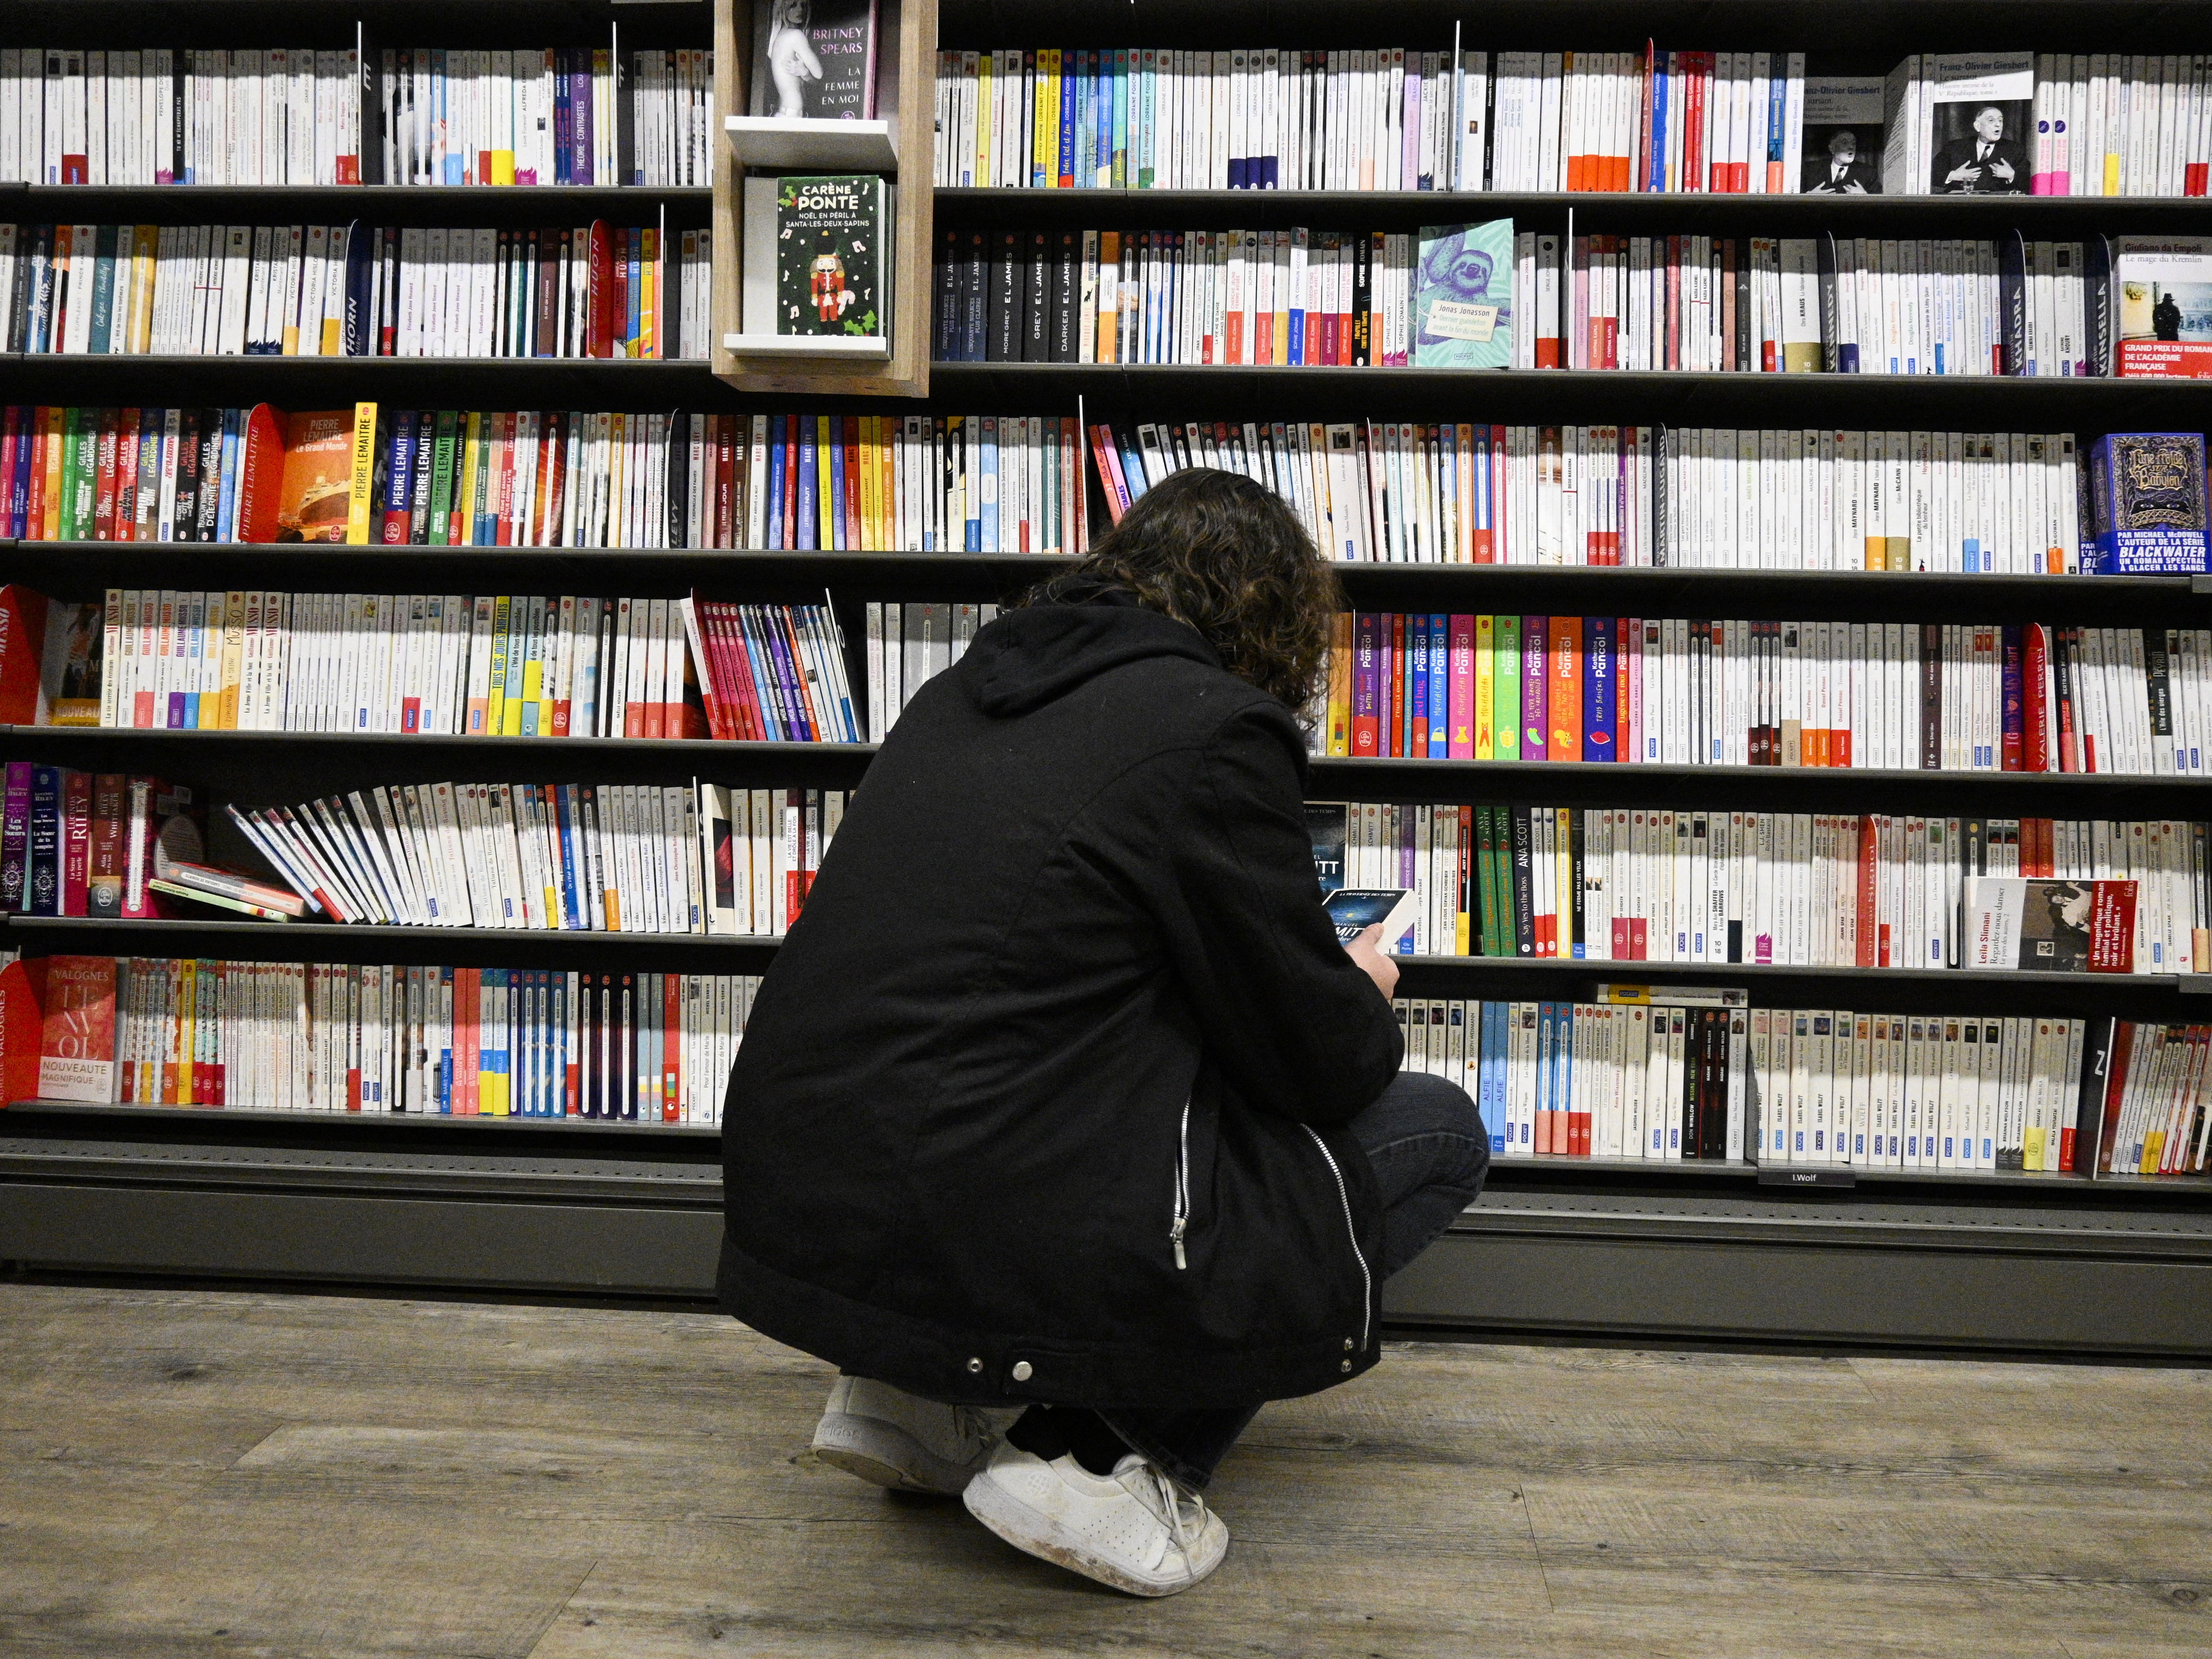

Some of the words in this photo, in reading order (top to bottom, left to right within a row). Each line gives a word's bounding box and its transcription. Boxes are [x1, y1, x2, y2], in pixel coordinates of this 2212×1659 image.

[813, 27, 864, 40] BRITNEY
[821, 42, 863, 55] SPEARS
[849, 67, 861, 76] LA
[825, 81, 860, 91] FEMME
[822, 96, 834, 105] EN
[838, 95, 859, 104] MOI
[577, 101, 585, 140] CONTRASTES
[802, 182, 851, 195] CARÈNE
[798, 195, 859, 211] PONTE
[2125, 243, 2159, 252] Giuliano
[2174, 243, 2202, 253] Empoli
[590, 237, 599, 296] HUON
[2137, 256, 2157, 264] mage
[2172, 254, 2202, 263] Kremlin
[1438, 304, 1458, 314] Jonas
[1459, 307, 1490, 317] Jonasson
[347, 297, 357, 353] HORN
[1440, 314, 1458, 324] Dernier
[1459, 317, 1487, 327] gueuleton
[1826, 283, 1836, 371] KENNEDY
[2012, 286, 2023, 366] KHADRA
[2097, 282, 2108, 373] KINSELLA
[1433, 324, 1448, 333] avant
[1471, 328, 1489, 337] monde
[2137, 353, 2181, 361] L'ACADÉMIE
[2125, 363, 2166, 371] FRANÇAISE
[305, 443, 324, 452] Grand
[326, 442, 347, 451] Monde
[357, 418, 371, 463] LEMAITRE
[79, 441, 88, 467] GILLES
[86, 430, 97, 477] LEGARDINIER
[247, 425, 259, 489] LEMAITRE
[355, 465, 367, 499] PIERRE
[1658, 434, 1667, 564] MARTIN-LUGAND
[243, 493, 255, 536] PIERRE
[2118, 538, 2157, 546] L'AUTEUR
[2183, 538, 2204, 546] SÉRIE
[2119, 546, 2206, 557] BLACKWATER
[105, 605, 121, 634] MUSSO
[495, 603, 509, 634] PARFAITS
[494, 635, 507, 655] JOURS
[1434, 634, 1445, 674] Pancol
[1595, 637, 1606, 678] Pancol
[493, 656, 505, 671] NOS
[493, 673, 504, 690] TOUS
[1595, 707, 1604, 722] TROIS
[2037, 705, 2046, 765] VALERIE
[72, 796, 88, 840] RILEY
[1516, 817, 1528, 849] SCOTT
[1517, 851, 1529, 868] ANA
[1520, 876, 1528, 890] Boss
[2124, 880, 2135, 897] folio
[1520, 892, 1529, 902] the
[1993, 887, 2005, 910] danser
[2097, 882, 2106, 906] roman
[1521, 911, 1530, 923] Yes
[2104, 894, 2115, 927] politique,
[1521, 924, 1530, 936] Say
[1980, 911, 1991, 942] Slimani
[2094, 909, 2106, 948] magnifique
[2103, 930, 2112, 938] et
[2111, 912, 2122, 941] brûlant.
[1990, 913, 2002, 964] Regardez-nous
[1978, 944, 1988, 964] Leïla
[2002, 945, 2010, 956] pays
[2093, 950, 2101, 960] Un
[2101, 940, 2112, 967] familial
[2110, 952, 2119, 966] noir
[55, 970, 109, 981] VALOGNES
[43, 1061, 107, 1074] NOUVEAUTÉ
[41, 1074, 94, 1084] MAGNIFIQUE
